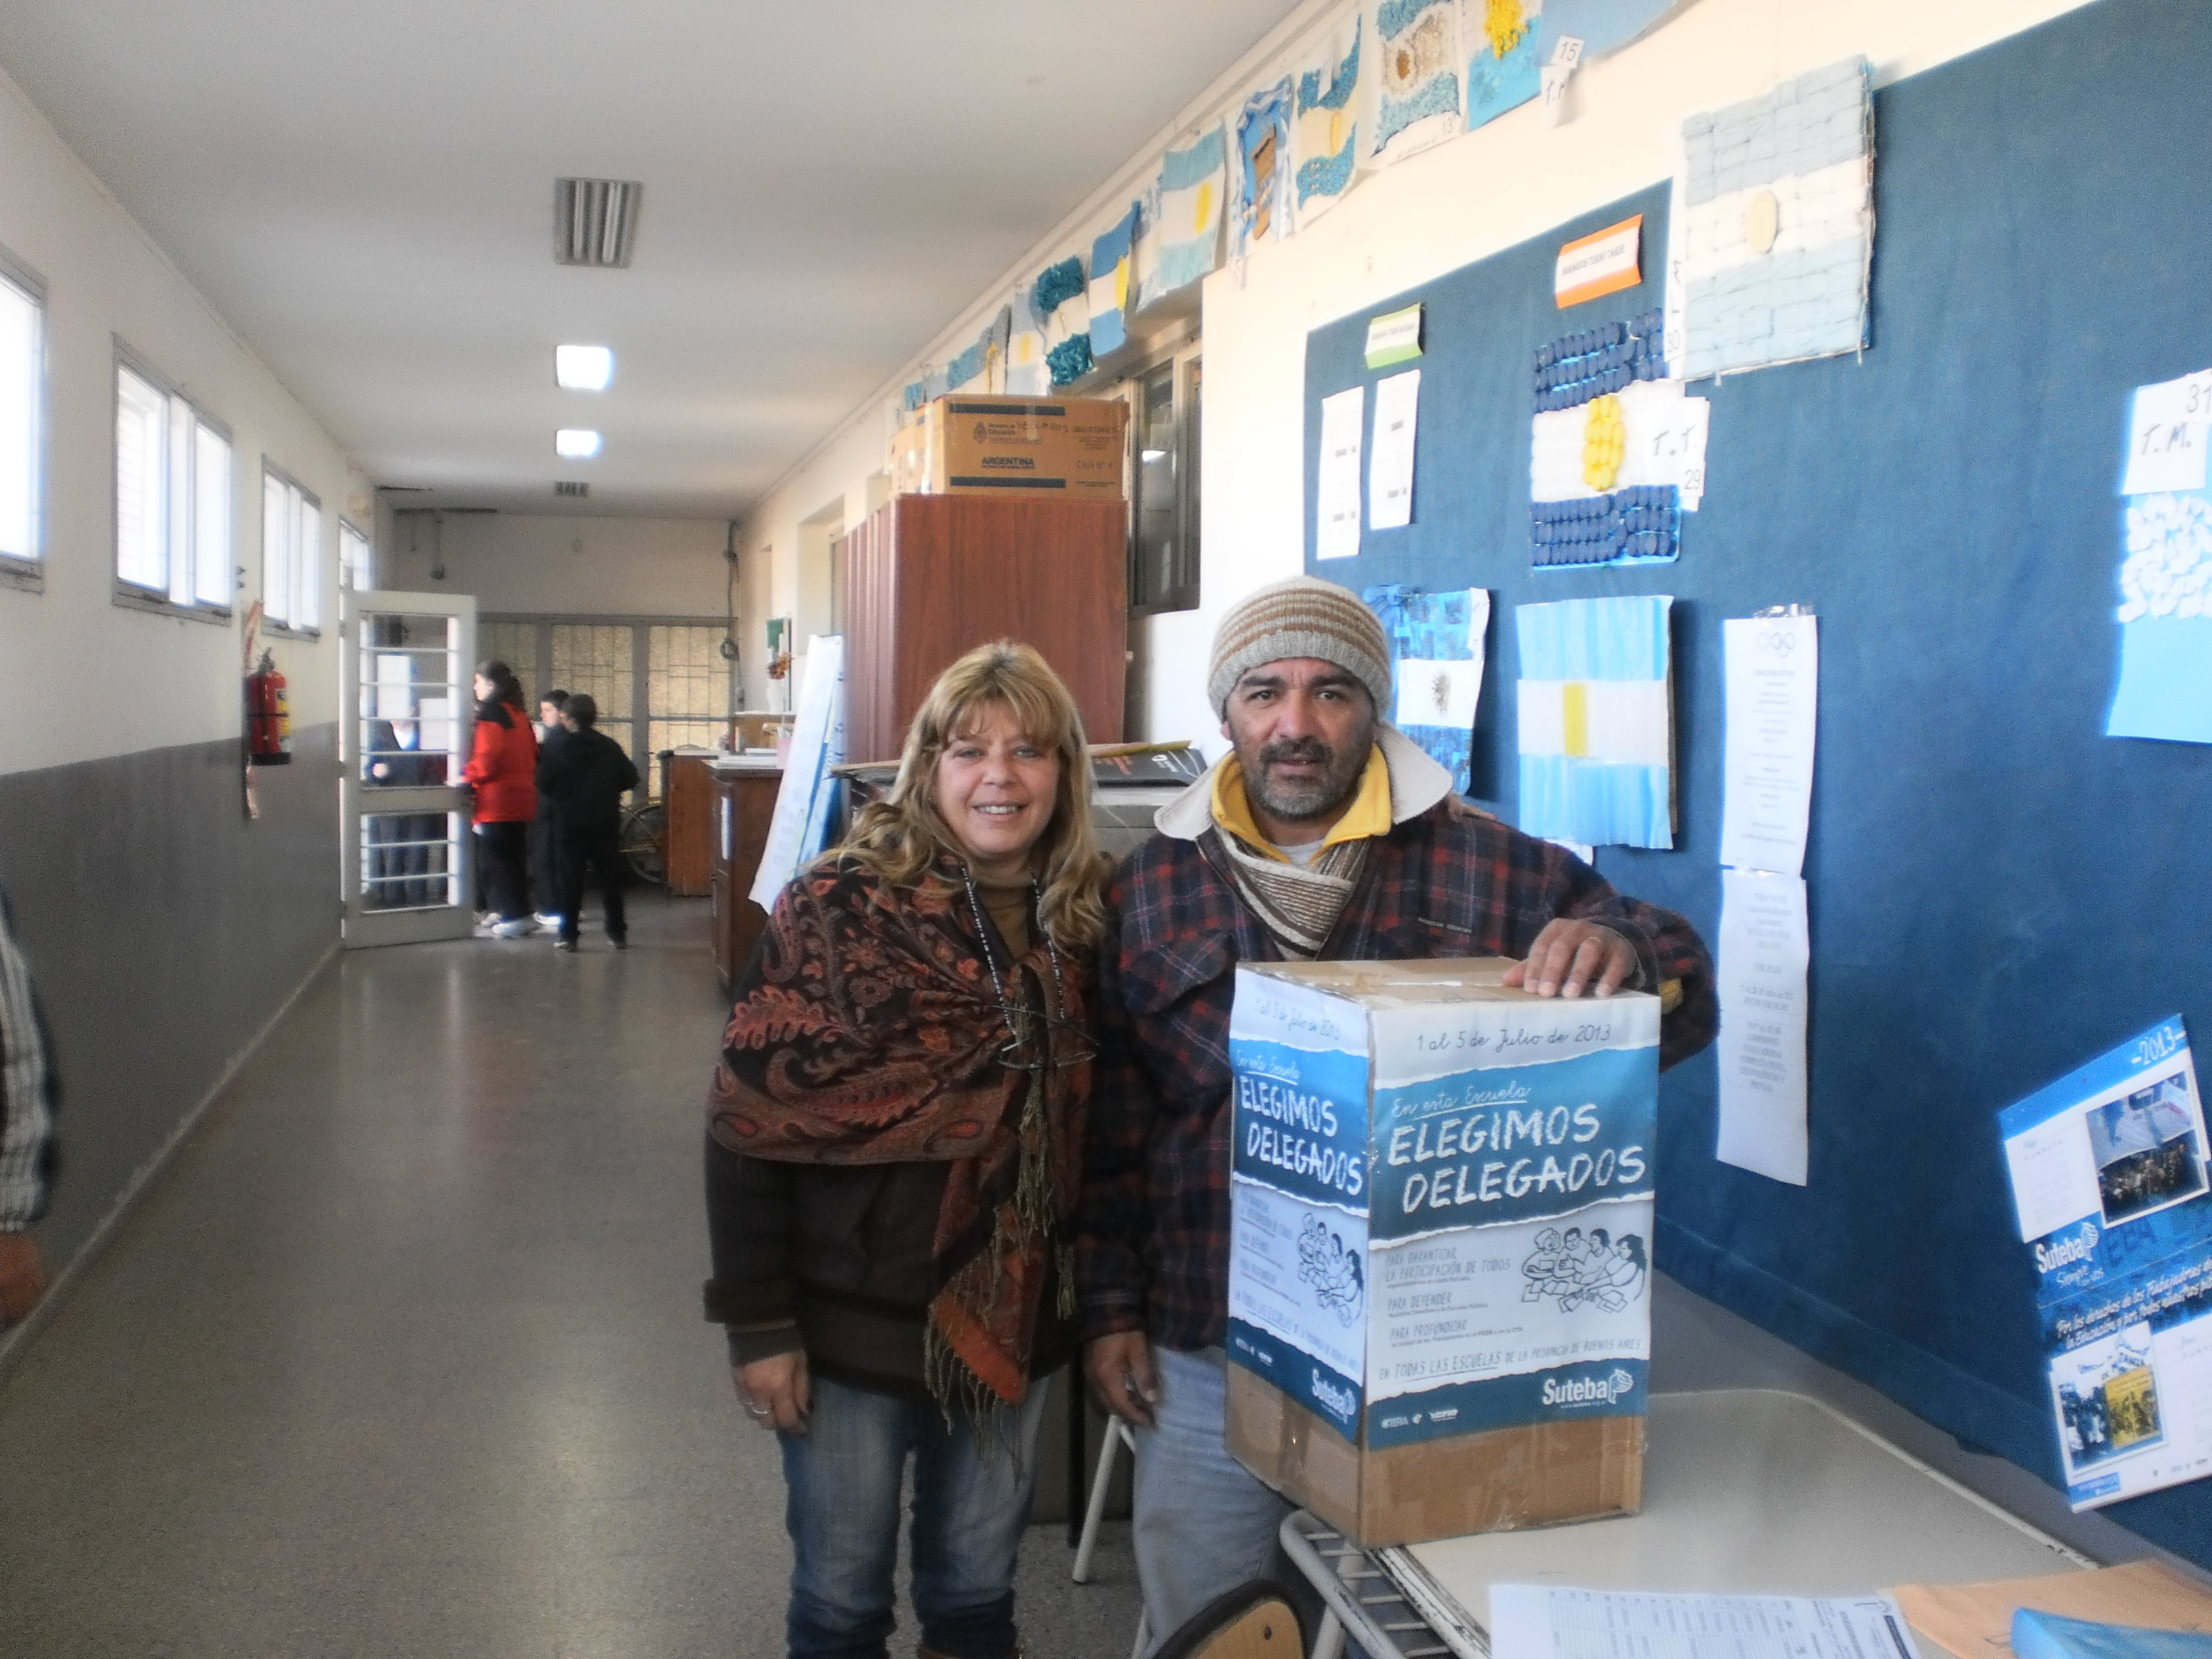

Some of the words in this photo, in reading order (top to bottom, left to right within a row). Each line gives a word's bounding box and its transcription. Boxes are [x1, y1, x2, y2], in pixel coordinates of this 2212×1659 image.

[1560, 41, 1579, 62] 15
[1666, 329, 1681, 353] 30
[982, 456, 1035, 466] ARGENTINA
[1684, 468, 1702, 490] 29
[1418, 1033, 1424, 1051] 1
[1429, 1032, 1450, 1050] al
[1456, 1030, 1467, 1048] 5
[1470, 1029, 1490, 1047] de
[1496, 1028, 1544, 1052] Julio
[1547, 1027, 1570, 1044] de
[1575, 1024, 1611, 1043] 2013
[1240, 1076, 1338, 1137] ELEGIMOS
[1392, 1098, 1418, 1118] En
[1424, 1092, 1458, 1111] esta
[1465, 1080, 1532, 1105] Escuela
[1387, 1103, 1600, 1166] ELEGIMOS
[1246, 1122, 1363, 1196] DELEGADOS
[1403, 1145, 1646, 1214] DELEGADOS
[1466, 1261, 1477, 1274] DE
[1481, 1257, 1511, 1272] TODOS
[2034, 1236, 2085, 1274] Suteba
[1410, 1292, 1452, 1308] DEFENDER
[1395, 1361, 1425, 1378] TODAS
[1430, 1357, 1450, 1374] LAS
[1452, 1351, 1502, 1370] ESCUELAS
[1505, 1351, 1515, 1364] DE
[1570, 1341, 1580, 1354] DE
[1312, 1368, 1346, 1415] Suteba
[1542, 1376, 1608, 1406] Suteba
